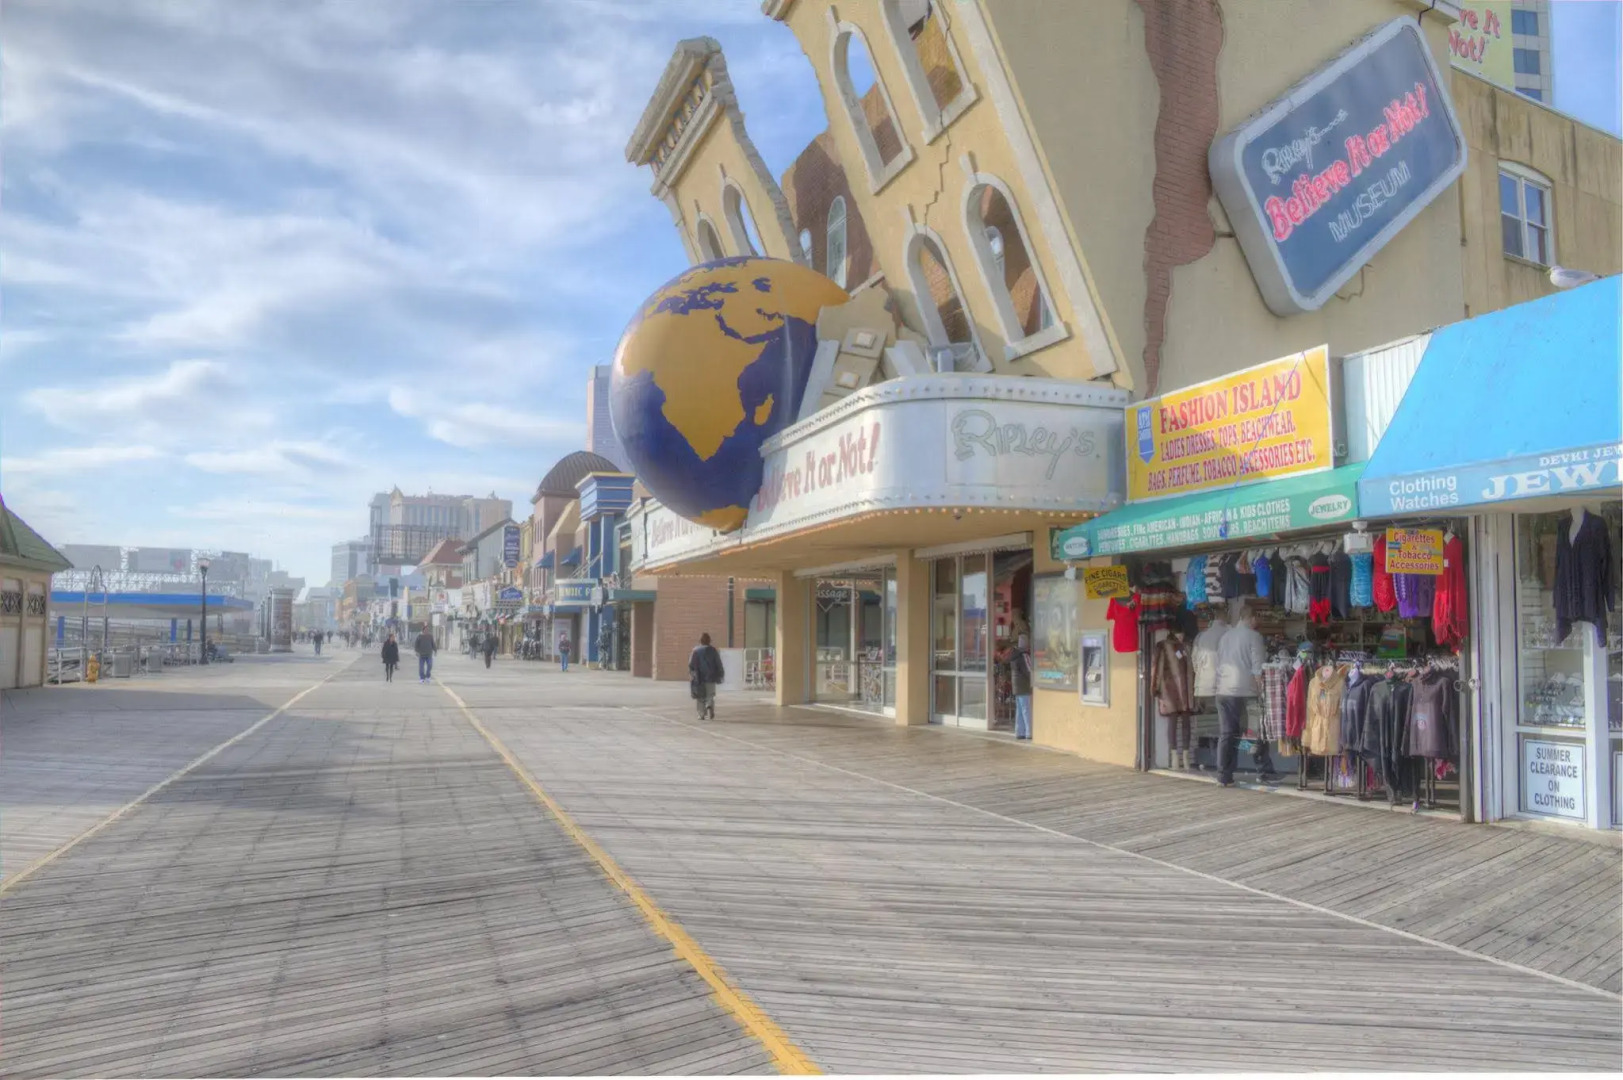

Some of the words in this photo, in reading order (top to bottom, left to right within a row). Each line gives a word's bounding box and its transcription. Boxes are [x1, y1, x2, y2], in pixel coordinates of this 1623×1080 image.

[1483, 8, 1501, 39] It
[1265, 160, 1351, 242] Believe
[1345, 134, 1372, 177] It
[1367, 124, 1390, 158] or
[1383, 82, 1430, 143] Not!
[1328, 160, 1411, 243] MUSEUM
[1160, 390, 1228, 434] FASHION
[1232, 370, 1301, 415] ISLAND
[804, 449, 816, 494] It
[818, 452, 836, 488] or
[837, 421, 880, 483] Not!
[1160, 436, 1185, 462] LADIES
[1540, 451, 1589, 467] DEVKI
[1203, 455, 1237, 481] TOBACCO
[1239, 446, 1294, 477] ACCESSORIES
[1295, 439, 1316, 464] ETC.
[1389, 475, 1457, 497] Clothing
[1482, 458, 1619, 500] JEW
[1311, 500, 1348, 515] JEWELRY
[1390, 491, 1459, 512] Watches
[1147, 518, 1176, 534] AMERICAN
[1180, 513, 1200, 528] INDIAN
[1240, 504, 1257, 518] KIDS
[1257, 498, 1290, 515] CLOTHES
[1243, 517, 1267, 533] BEACH
[1267, 514, 1290, 530] ITEMS
[1394, 532, 1436, 544] Cigarettes
[1390, 560, 1439, 570] Accessories
[1397, 550, 1432, 560] Tobacco
[1084, 570, 1100, 584] FINE
[1536, 747, 1571, 762] SUMMER
[1530, 761, 1578, 778] CLEARANCE
[1548, 780, 1560, 791] ON
[1534, 793, 1575, 810] CLOTHING
